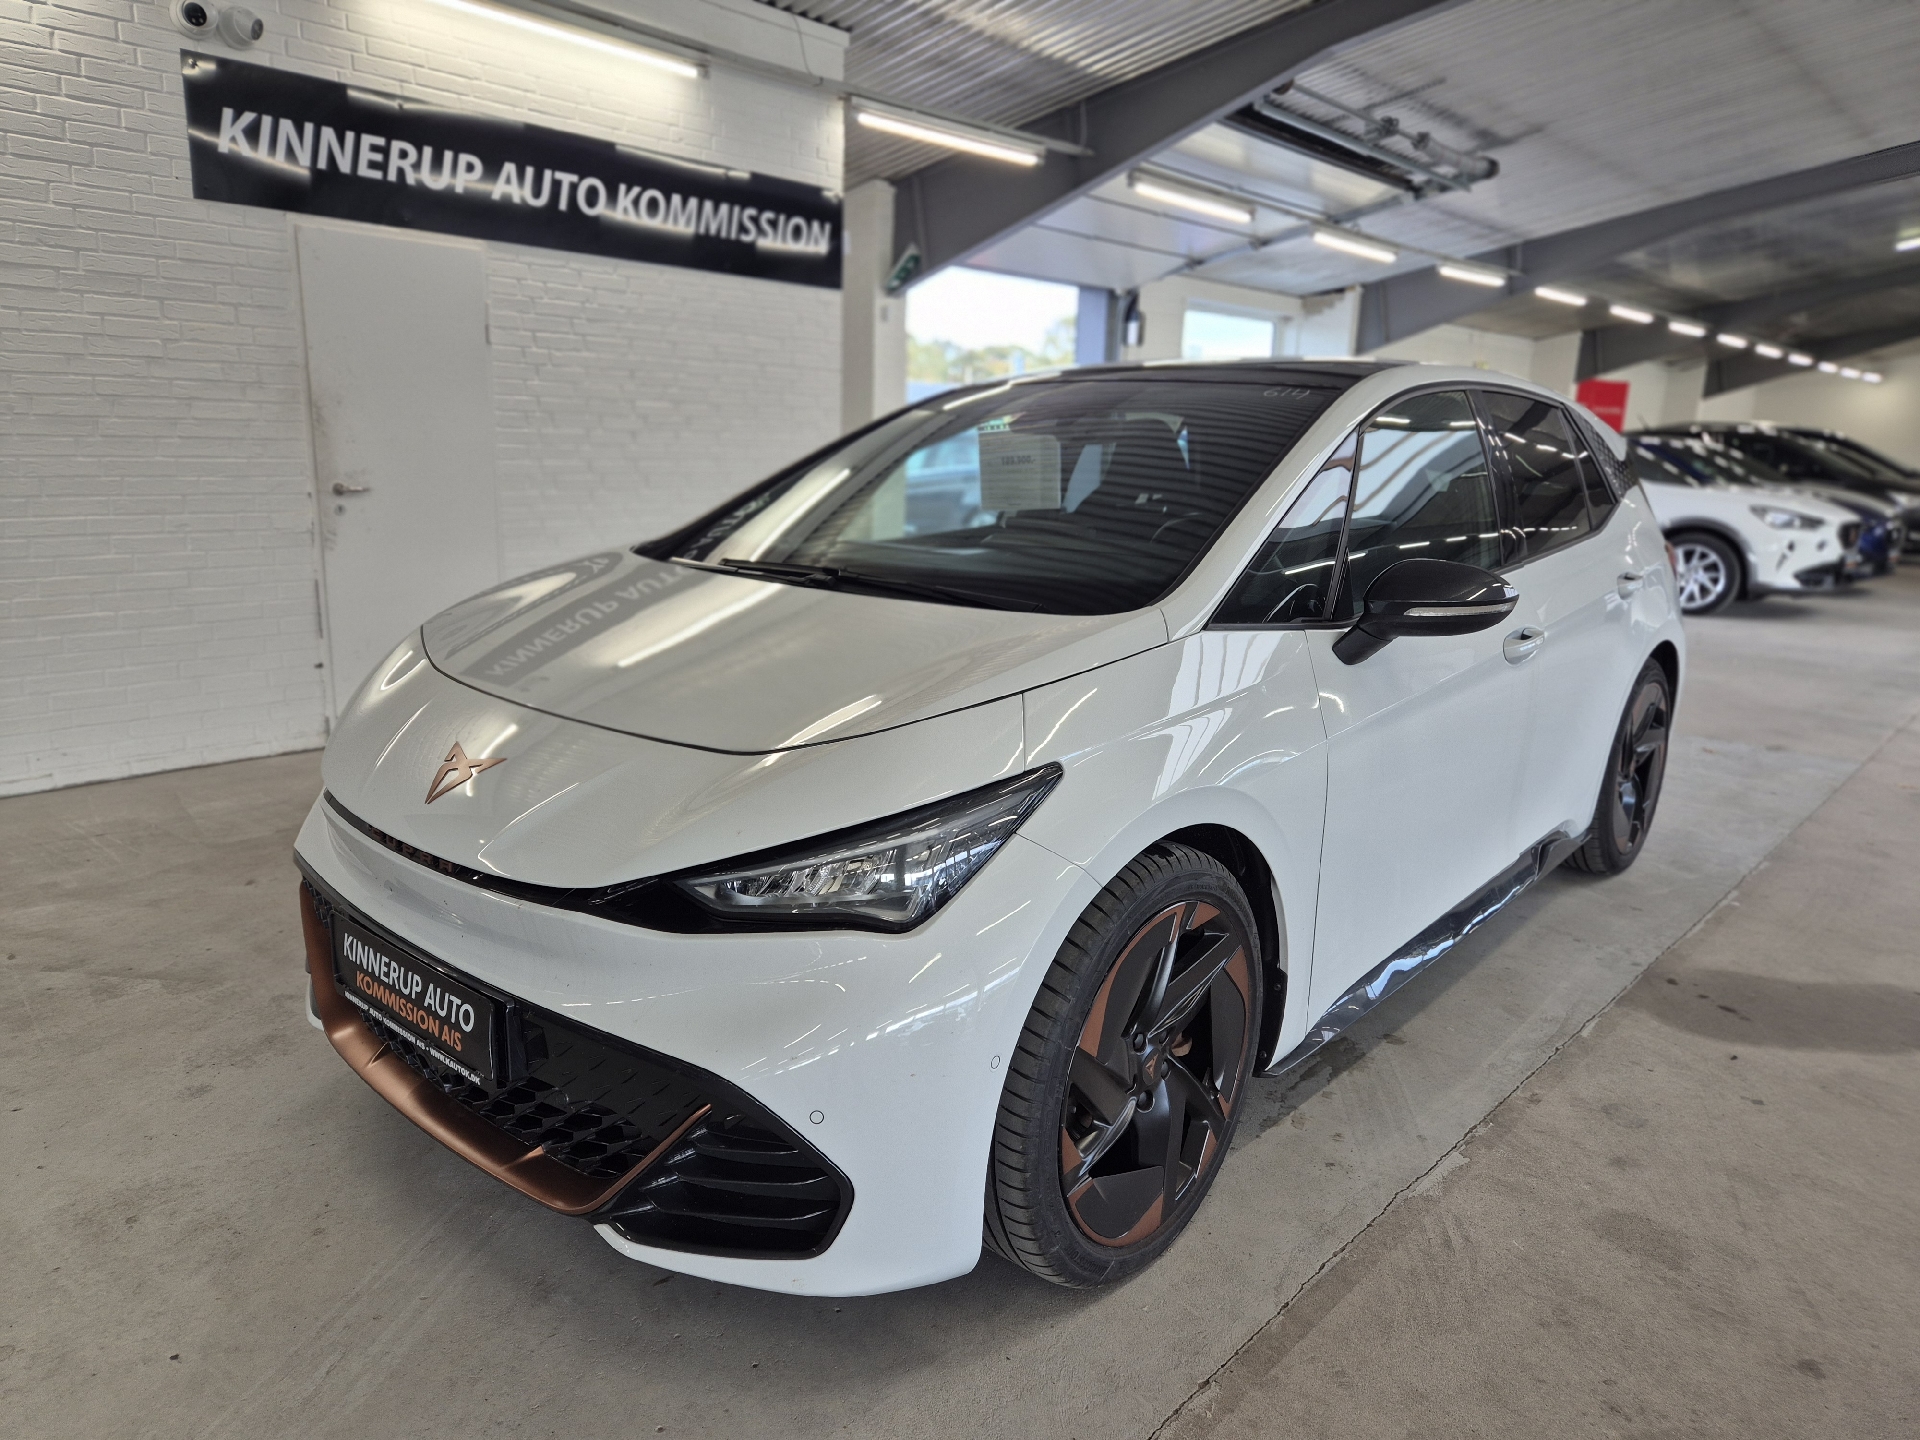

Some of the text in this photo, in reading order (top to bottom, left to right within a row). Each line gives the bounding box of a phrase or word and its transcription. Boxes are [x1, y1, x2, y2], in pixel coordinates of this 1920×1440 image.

[218, 107, 832, 250] KINNERUP AUTO KOMMISSION
[343, 932, 475, 1033] KINNERUP AUTO
[344, 990, 369, 1011] KINNERUP
[369, 1007, 382, 1021] AUTO
[382, 1017, 416, 1045] KOMMISSION
[356, 970, 440, 1038] KOMMISSION
